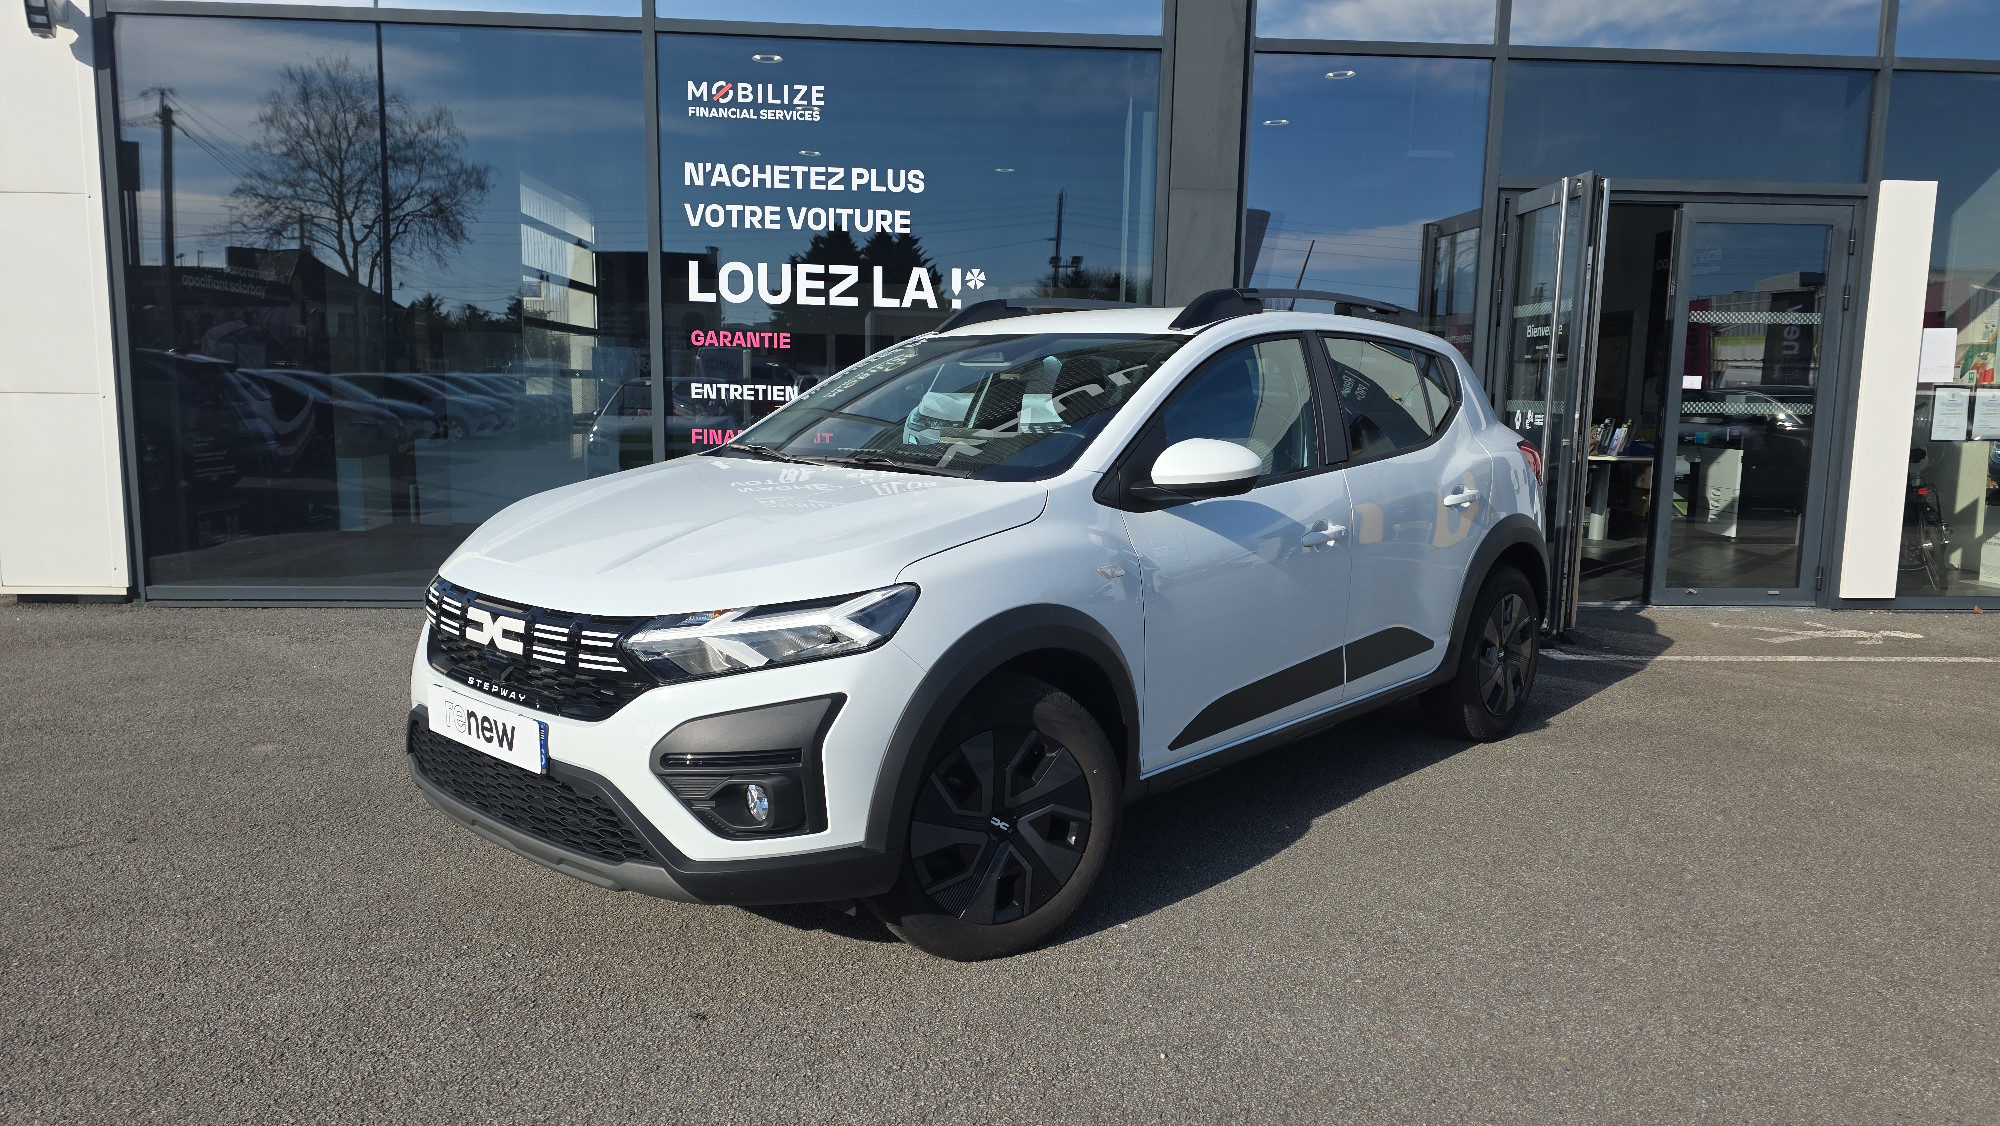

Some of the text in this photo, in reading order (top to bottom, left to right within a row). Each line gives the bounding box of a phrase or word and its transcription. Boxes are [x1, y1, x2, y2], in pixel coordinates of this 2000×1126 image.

[688, 106, 821, 121] FINANCIAL SERVICES
[684, 161, 925, 194] N'ACHETEZ PLUS
[684, 203, 911, 234] VOTRE VOITURE
[182, 274, 265, 298] opacifiant solarbay
[688, 260, 859, 307] LOUEZ
[873, 265, 939, 309] LA
[691, 330, 791, 349] GARANTIE
[1526, 323, 1563, 338] Bienvee
[691, 382, 799, 402] ENTRETIEN
[467, 677, 526, 701] STEPWAY
[445, 699, 516, 752] renew
